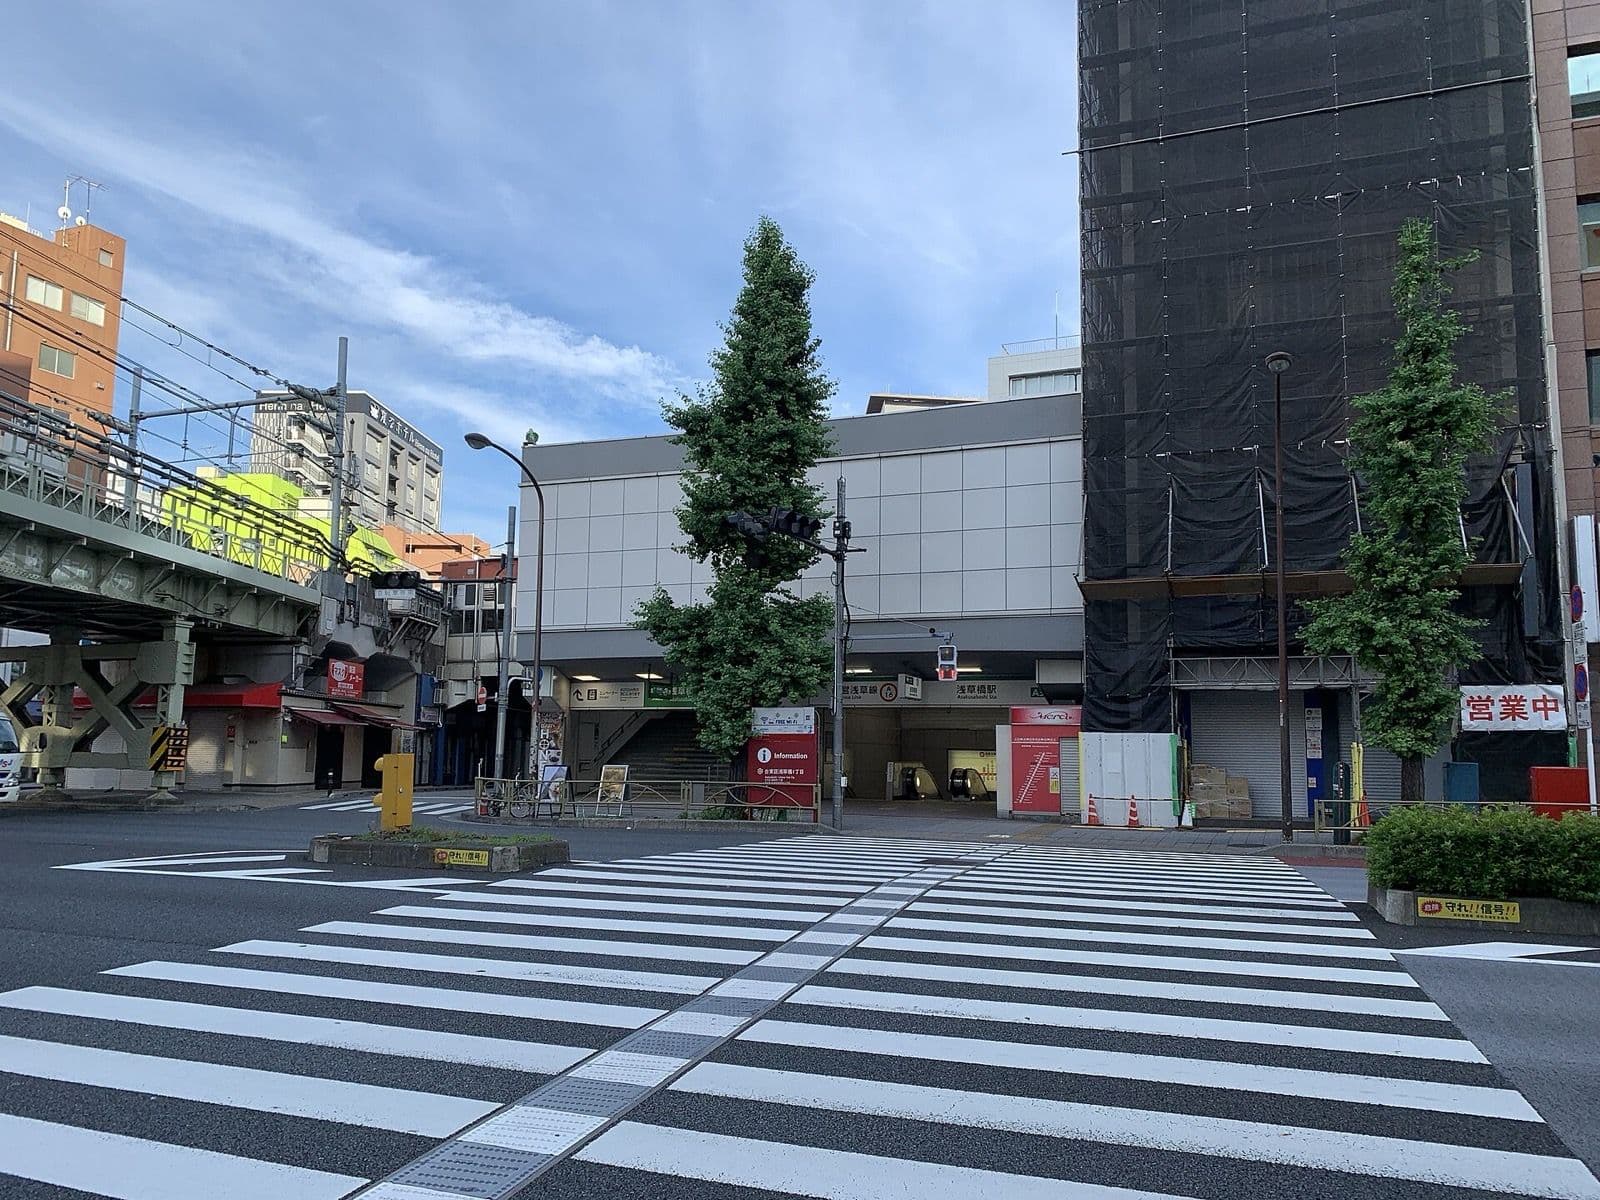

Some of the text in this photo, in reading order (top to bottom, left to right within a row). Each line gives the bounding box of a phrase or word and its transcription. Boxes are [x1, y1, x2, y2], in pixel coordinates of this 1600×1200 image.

[956, 684, 997, 694] 浅草橋駅
[1466, 695, 1559, 721] 営業中
